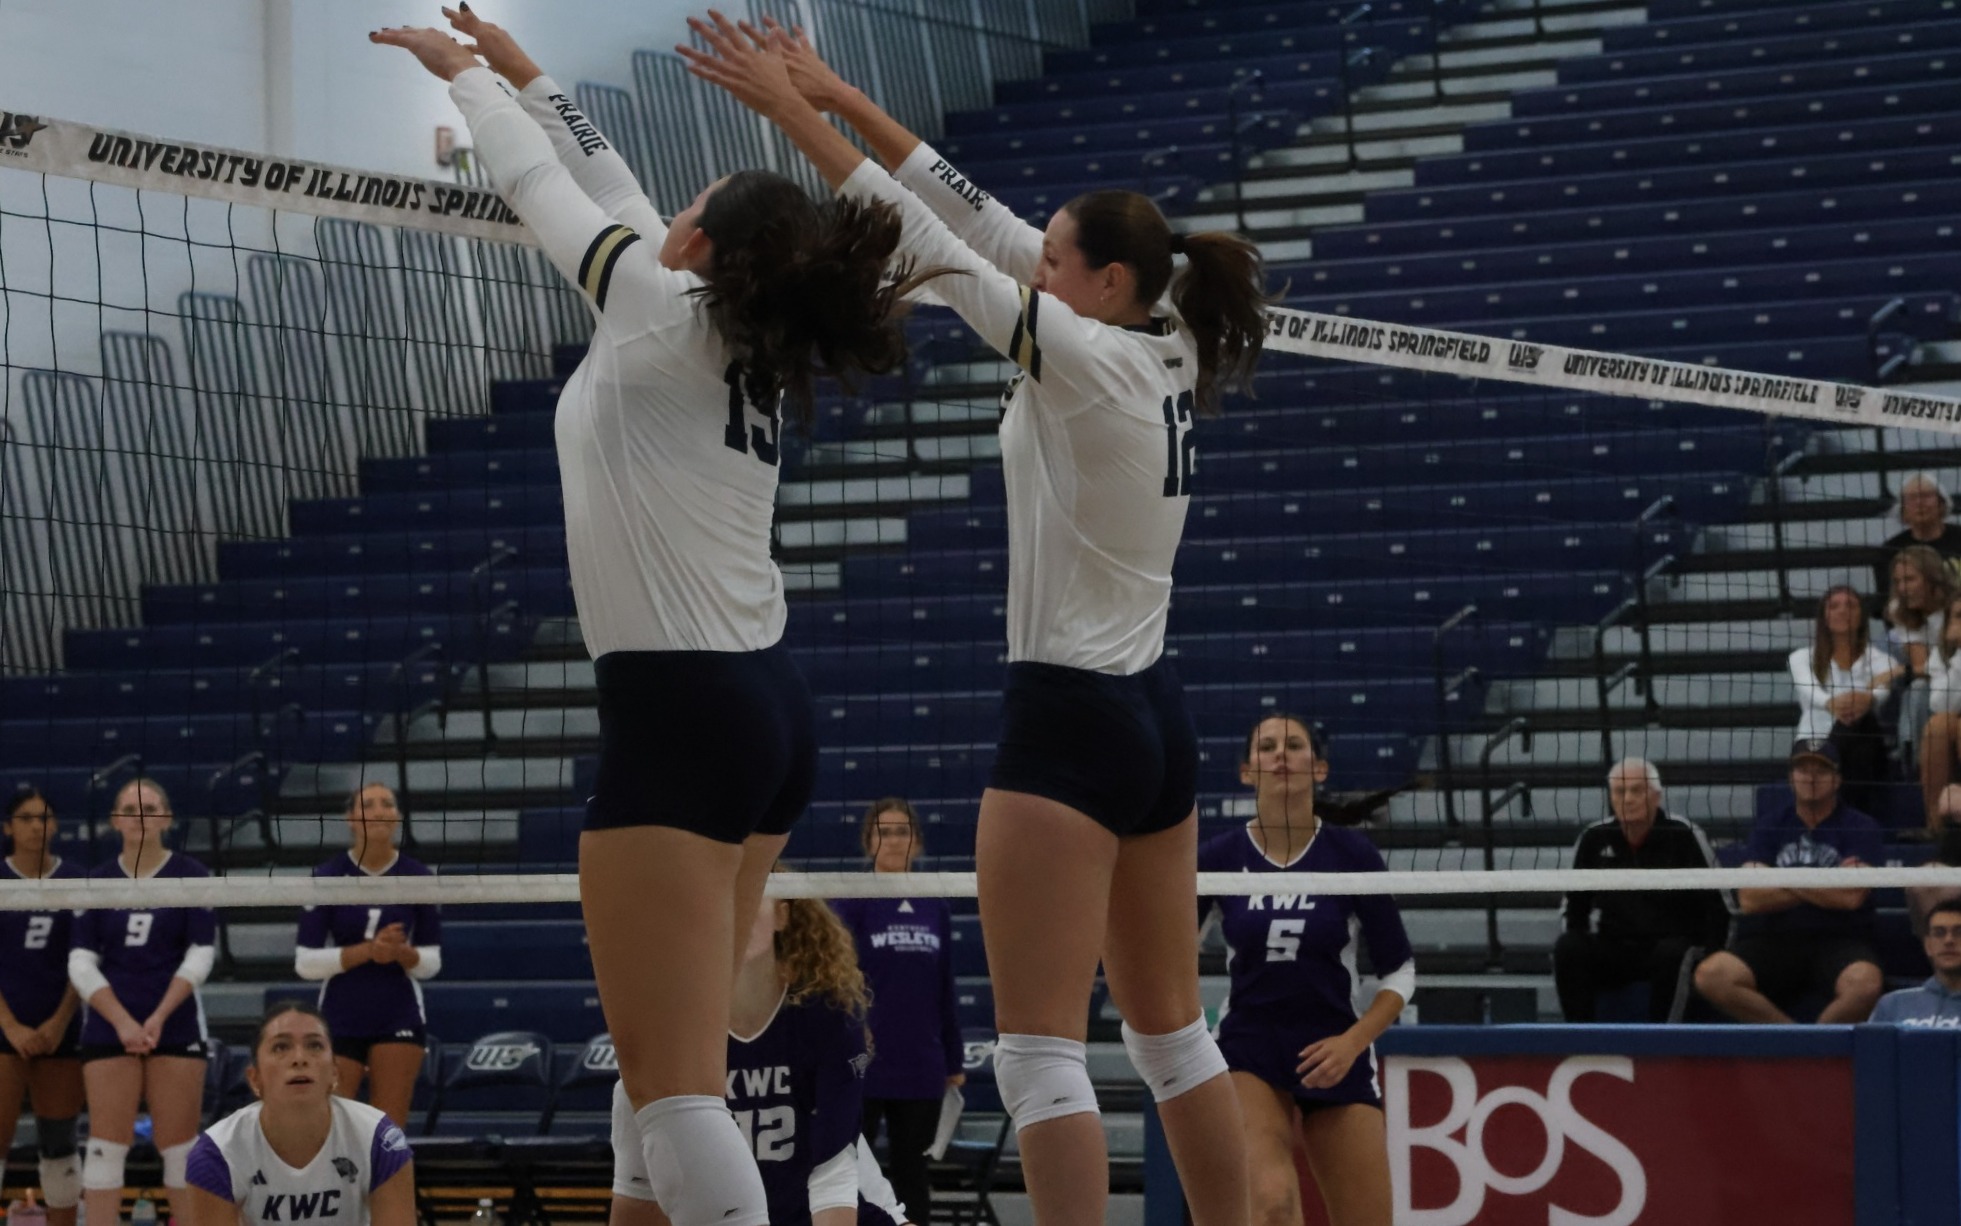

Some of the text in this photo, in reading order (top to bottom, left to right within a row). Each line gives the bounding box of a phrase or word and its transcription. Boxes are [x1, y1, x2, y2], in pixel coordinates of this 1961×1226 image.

[88, 132, 524, 227] UNIVERSITY OF ILLINOIS SPRIN
[1288, 316, 1311, 339] OF
[1311, 320, 1385, 350] ILLINOIS
[1388, 330, 1490, 363] SPRINGFIELD
[1563, 354, 1650, 382] UNIVERSITY
[1651, 364, 1670, 385] OF
[1670, 366, 1732, 393] ILLINOIS
[24, 916, 54, 949] 2
[125, 913, 154, 946] 9
[364, 908, 382, 940] 1
[1266, 919, 1306, 962] 5
[1903, 1014, 1961, 1029] adid
[262, 1189, 341, 1222] KWC
